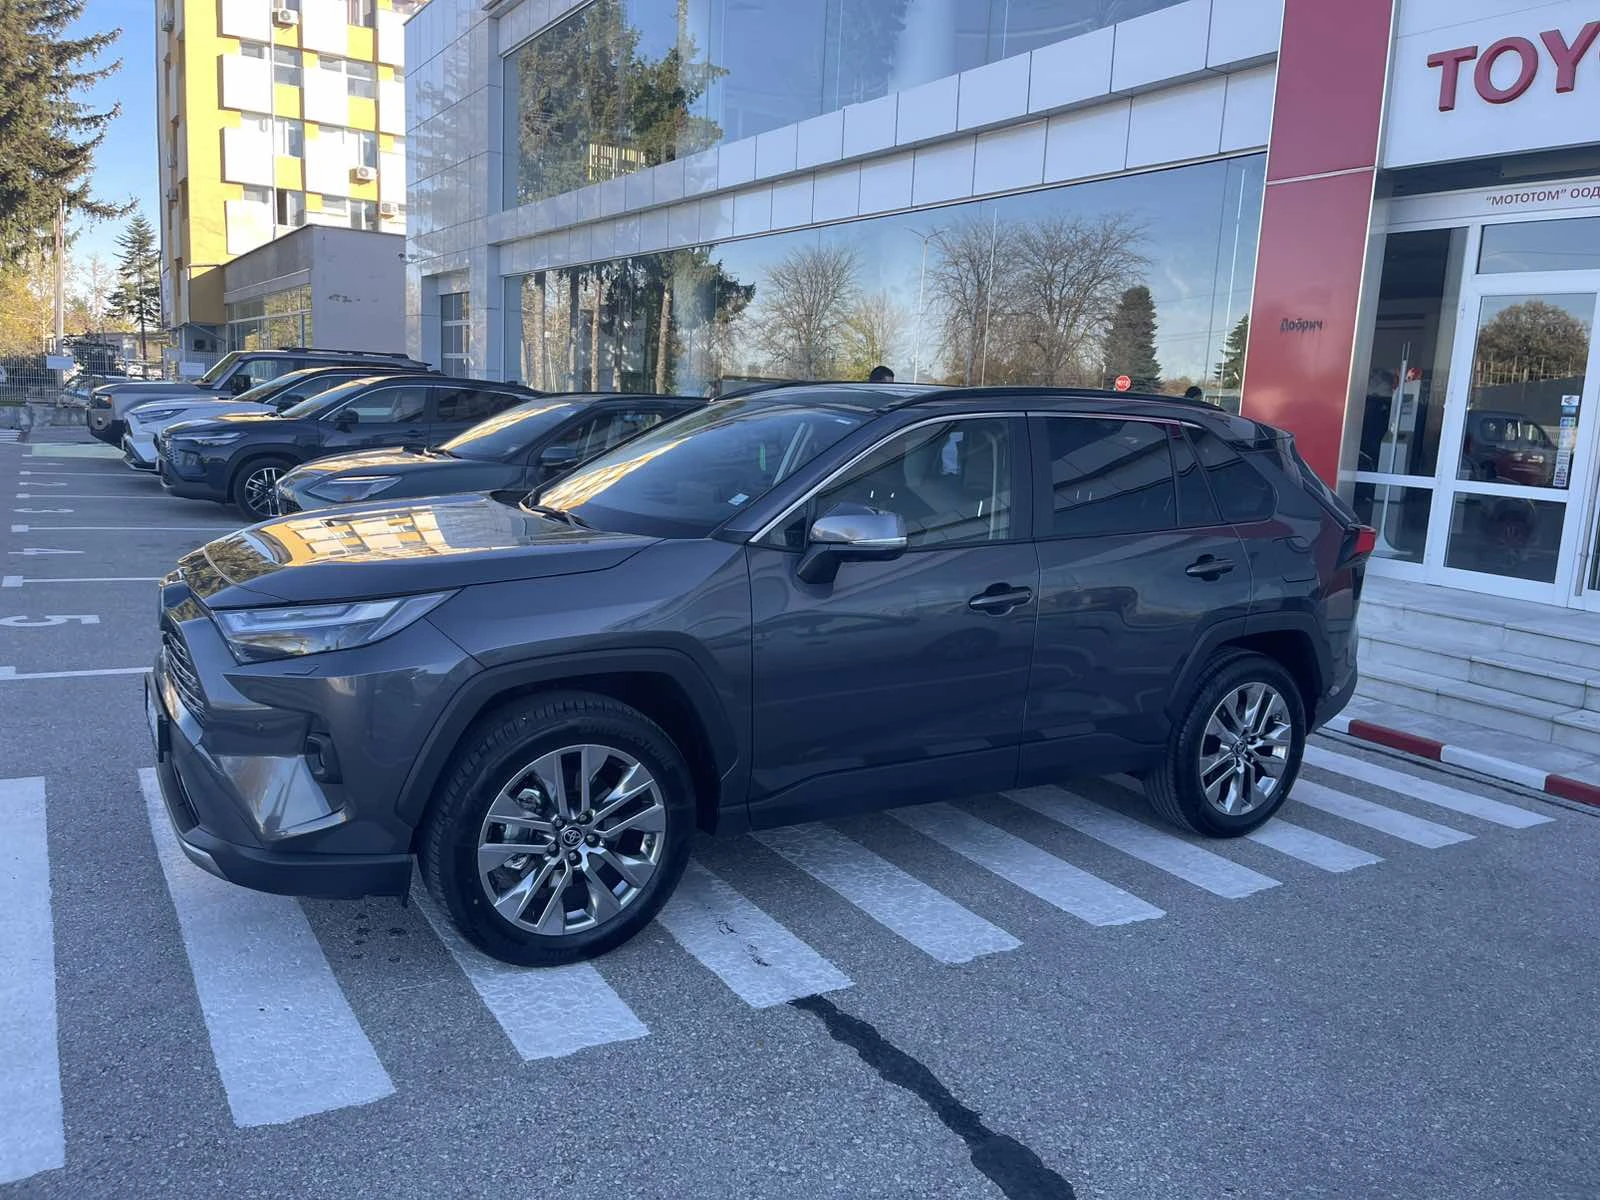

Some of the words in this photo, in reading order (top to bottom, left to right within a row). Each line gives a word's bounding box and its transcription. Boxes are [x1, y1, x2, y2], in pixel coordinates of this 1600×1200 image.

[1427, 20, 1600, 112] TOY
[1279, 318, 1323, 333] Добрич
[0, 614, 100, 627] 5
